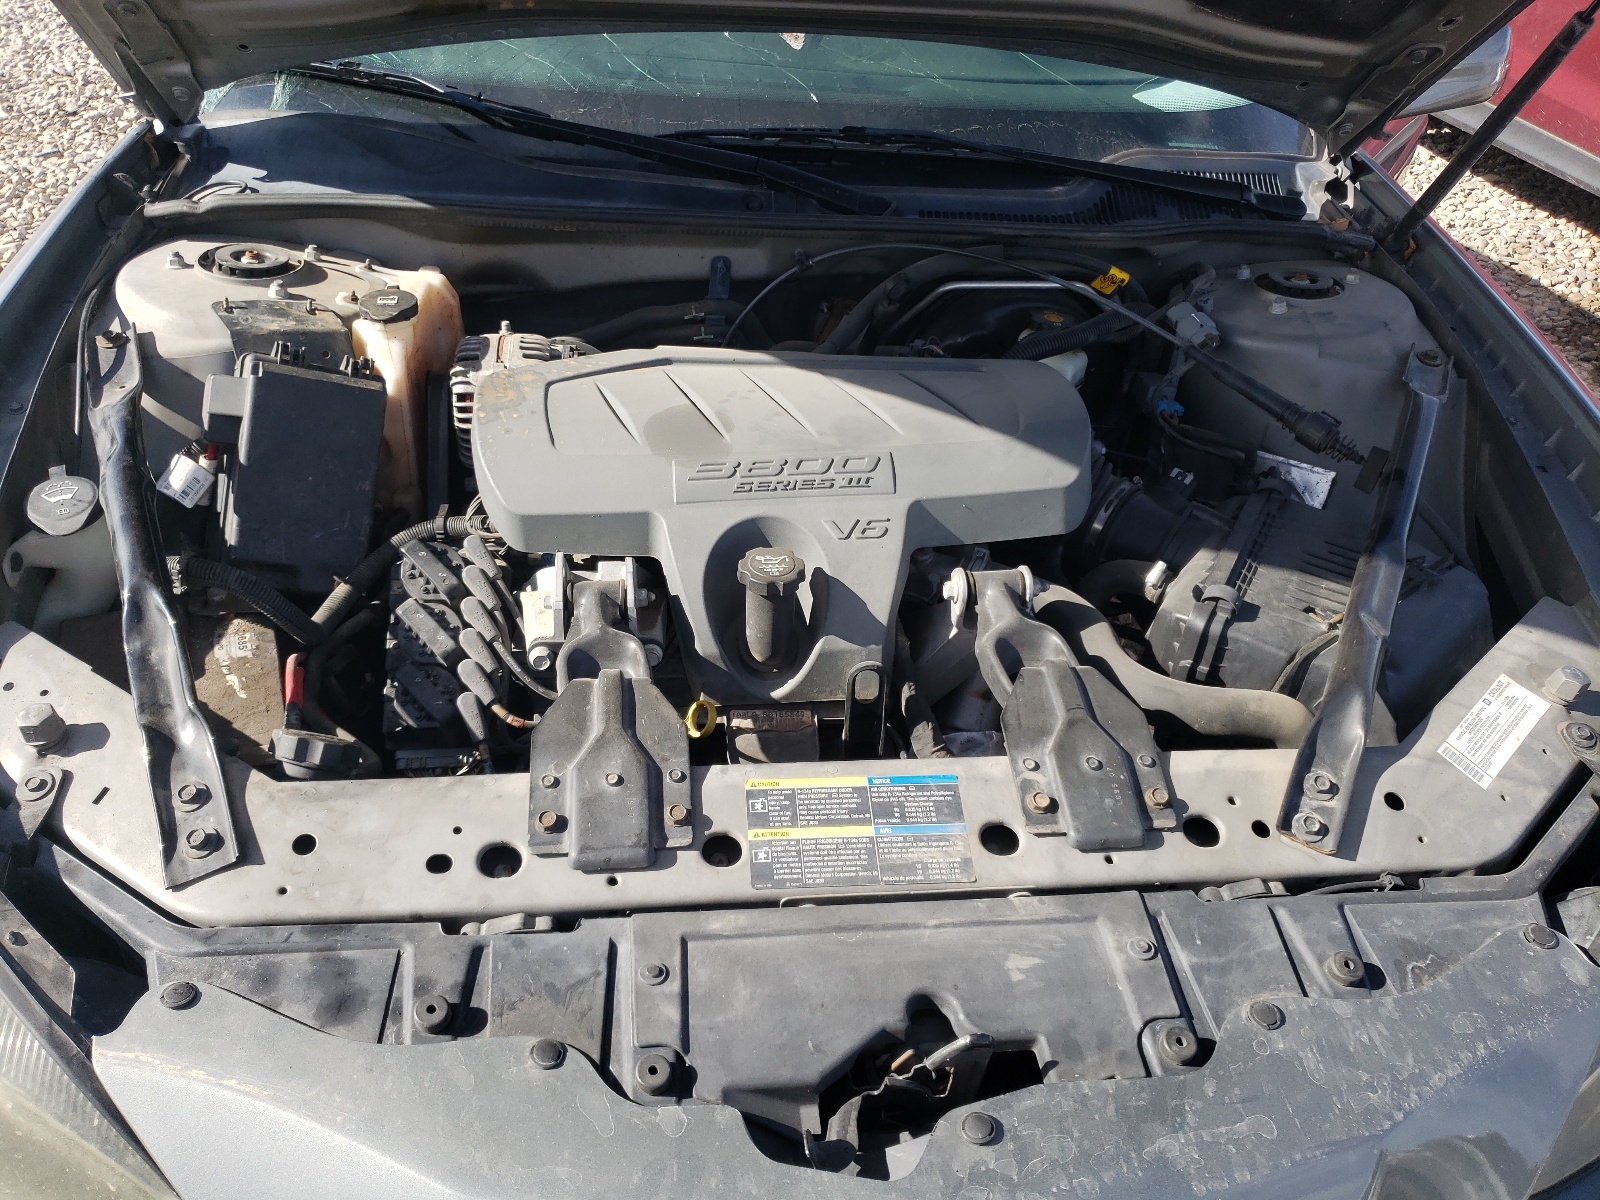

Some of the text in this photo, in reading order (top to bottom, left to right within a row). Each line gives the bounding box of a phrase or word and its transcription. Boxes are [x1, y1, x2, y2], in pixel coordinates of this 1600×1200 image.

[688, 455, 881, 481] 3800
[733, 477, 874, 494] SERIES III
[821, 518, 890, 540] V6
